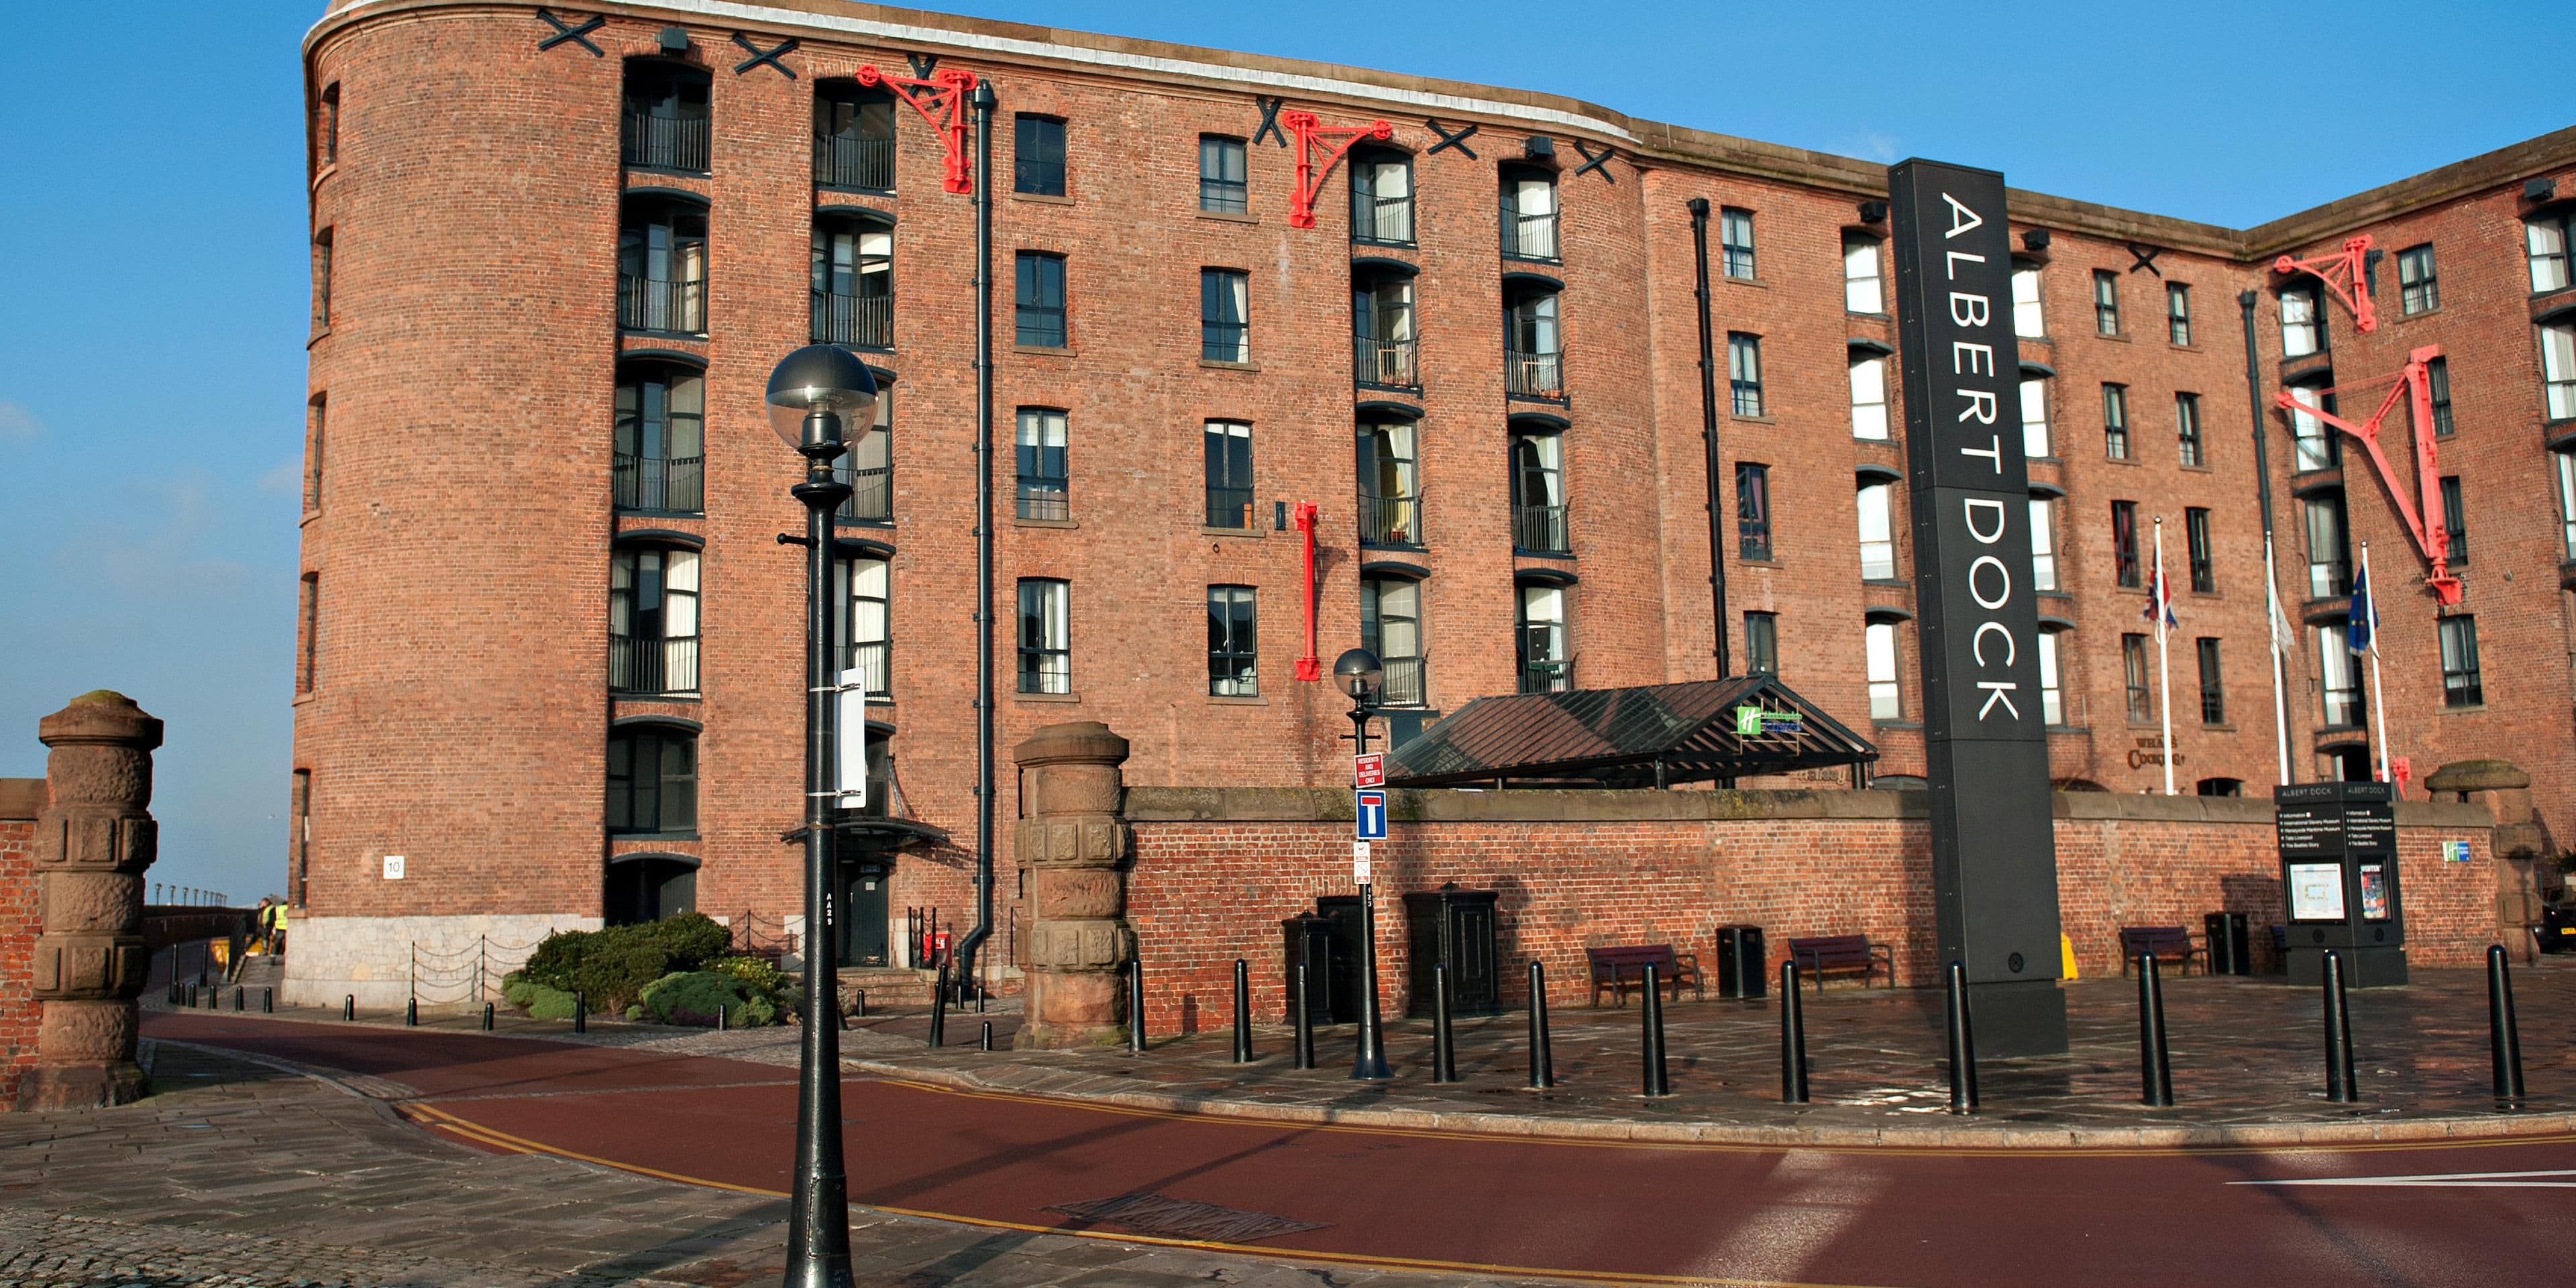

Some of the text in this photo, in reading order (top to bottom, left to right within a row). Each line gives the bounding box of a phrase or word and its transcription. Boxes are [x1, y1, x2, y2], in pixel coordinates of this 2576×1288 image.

[1942, 191, 2019, 722] ALBERT DOCK
[2282, 788, 2332, 797] ALBERT DOCK
[2347, 786, 2385, 794] ALBERT DOCK
[388, 861, 400, 873] 10
